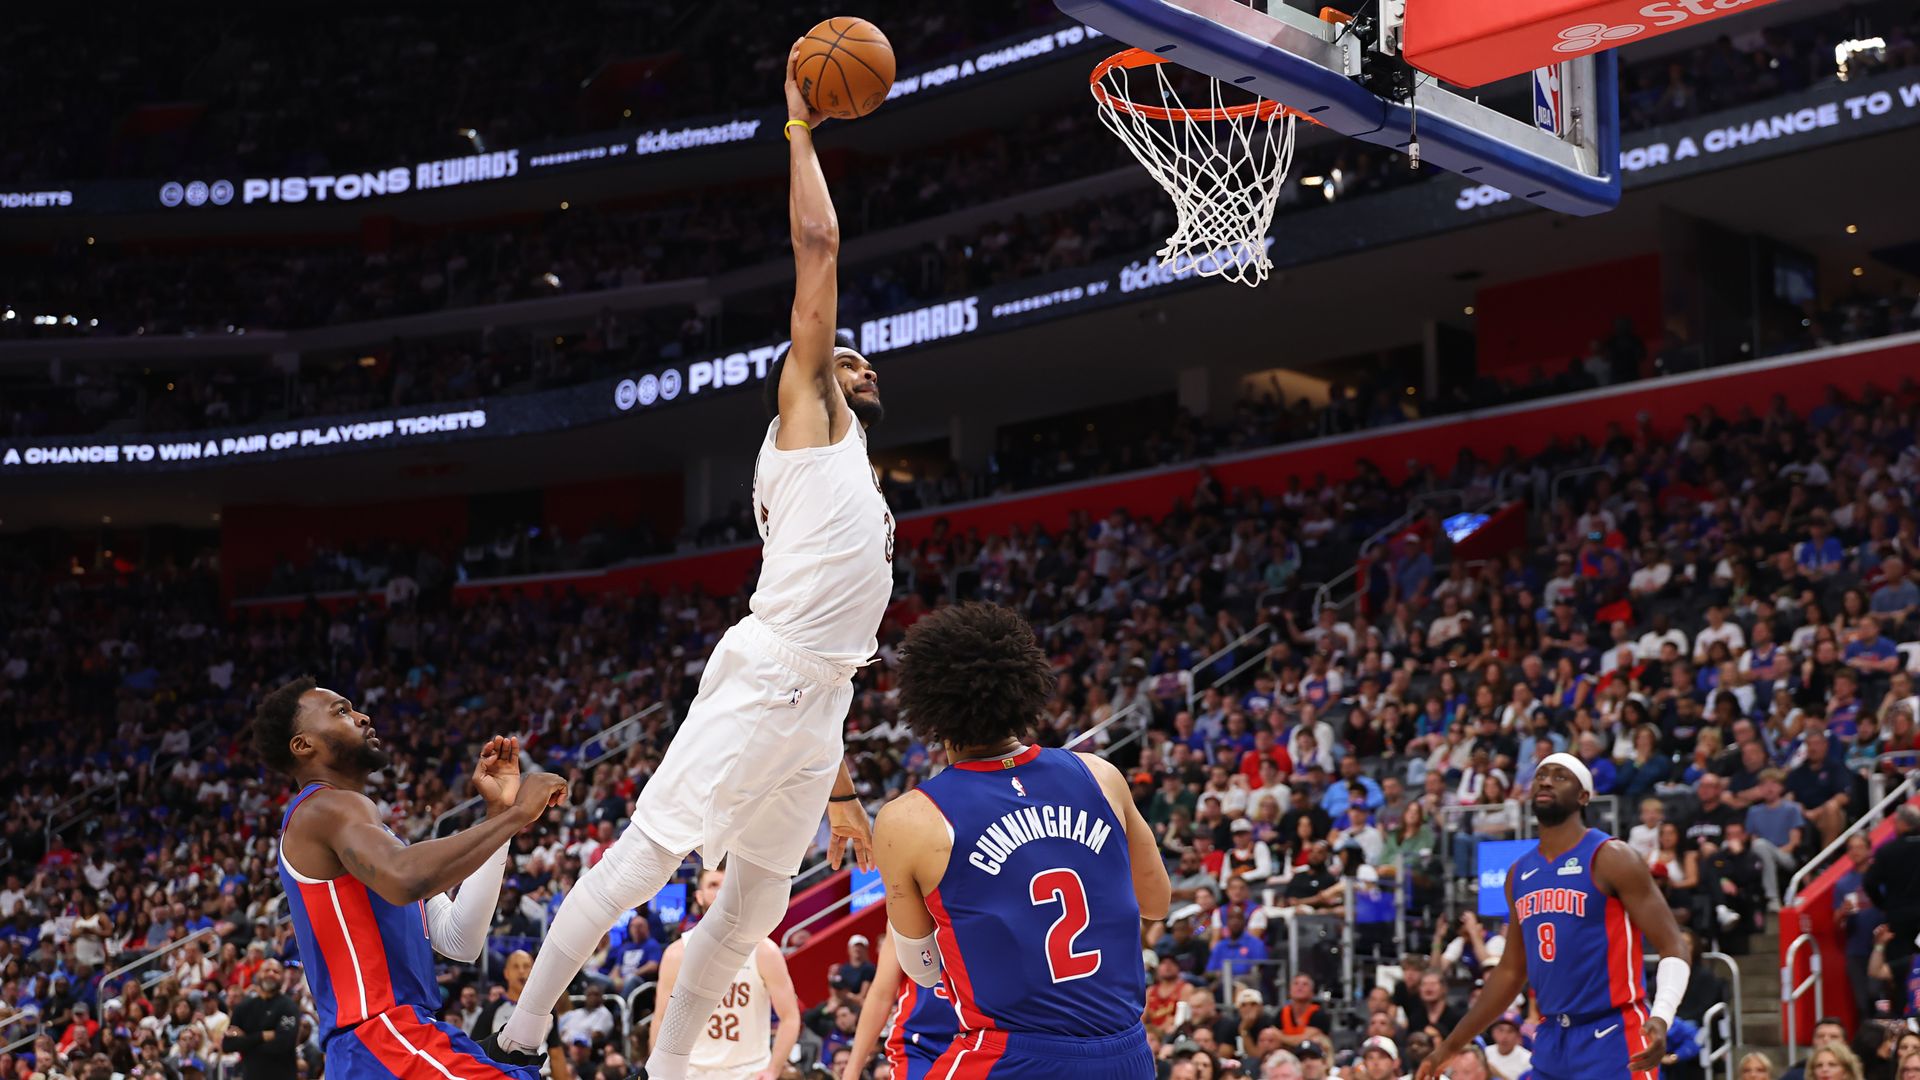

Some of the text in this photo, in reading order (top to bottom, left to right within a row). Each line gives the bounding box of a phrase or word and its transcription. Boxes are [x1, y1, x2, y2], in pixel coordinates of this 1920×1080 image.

[885, 76, 921, 100] OW
[921, 64, 959, 89] FOR
[960, 59, 976, 77] A
[976, 35, 1054, 72] CHANCE
[1054, 26, 1084, 47] TO
[1674, 136, 1699, 160] A
[1703, 102, 1840, 152] CHANCE
[1844, 91, 1893, 120] TO
[243, 166, 411, 203] PISTONS
[415, 149, 519, 190] REWARDS
[609, 144, 629, 156] BY
[636, 119, 761, 154] ticketmaster
[0, 190, 73, 208] ICKETS
[860, 296, 980, 356] REWARDS
[991, 286, 1084, 319] PRESENTED
[1085, 280, 1110, 297] BY
[3, 409, 487, 465] A CHANCE TO WIN A PAIR OF PLAYOFF TICKETS
[968, 805, 1112, 876] CUNNINGHAM
[1029, 867, 1102, 984] 2
[1515, 887, 1588, 924] DETROIT
[1537, 922, 1556, 963] 8
[707, 1012, 740, 1042] 32
